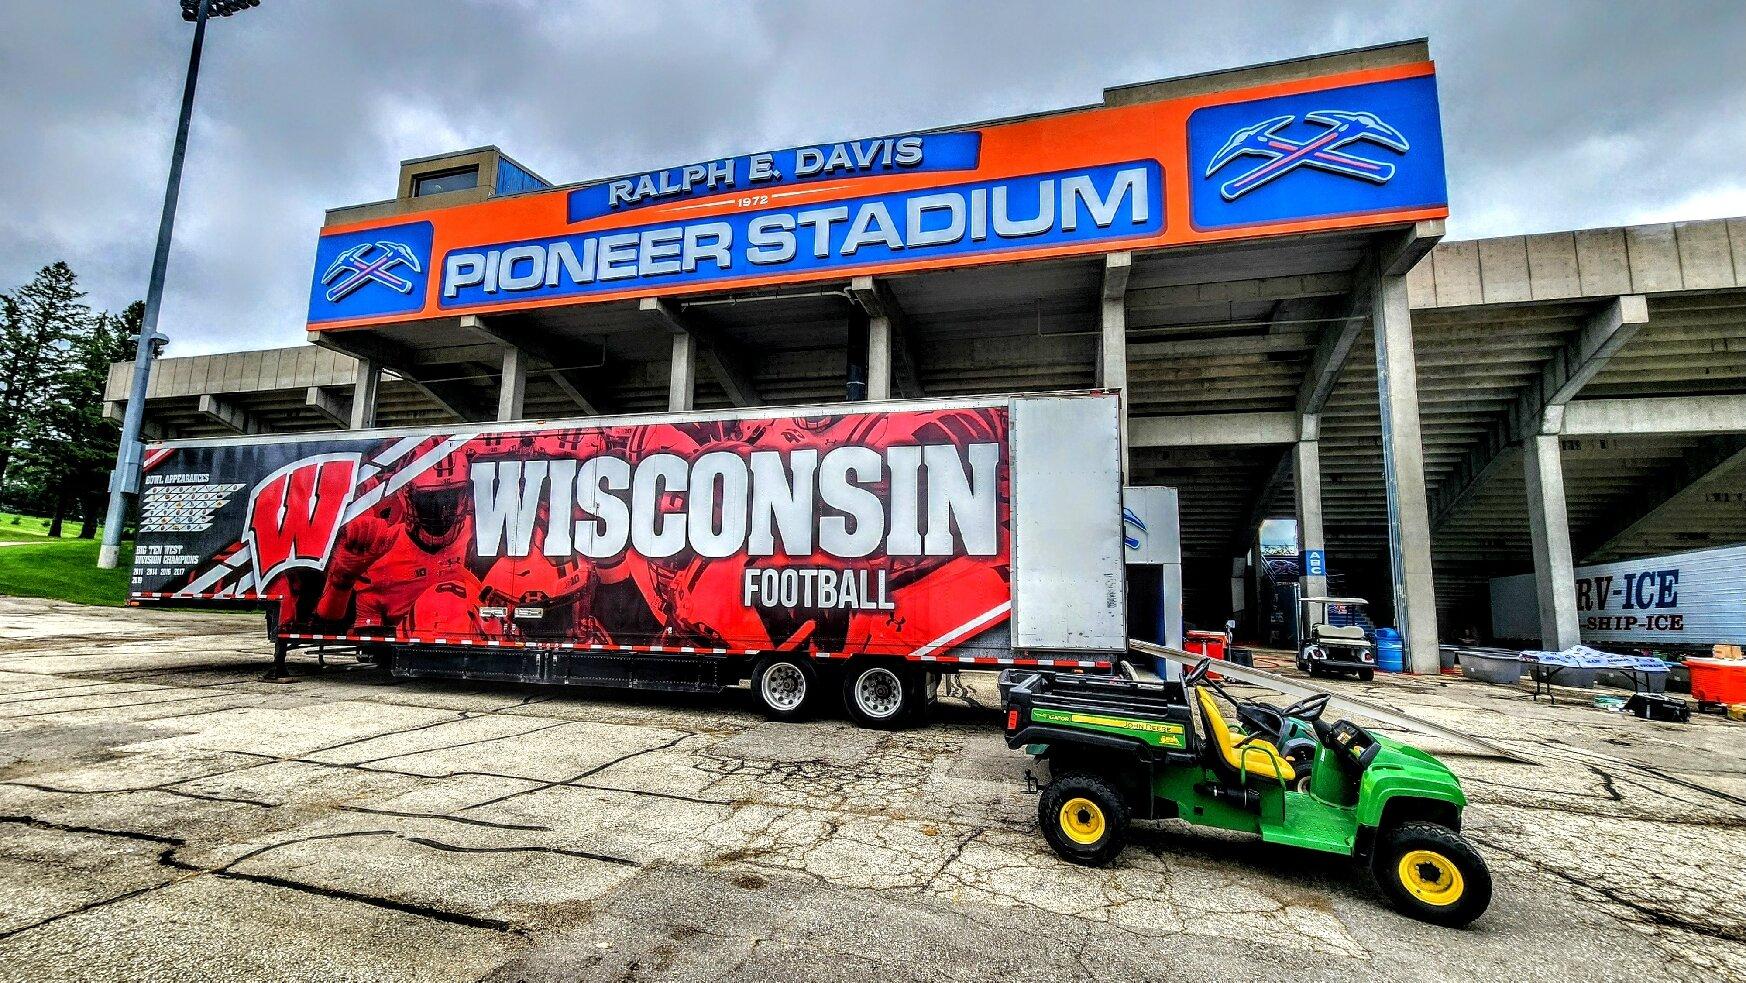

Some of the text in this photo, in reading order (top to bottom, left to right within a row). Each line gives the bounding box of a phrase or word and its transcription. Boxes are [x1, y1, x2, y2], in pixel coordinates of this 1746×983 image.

[608, 136, 923, 208] RALPH E. DAVIS
[737, 195, 768, 208] 1972
[443, 167, 1149, 298] PIONEER STADIUM
[145, 473, 210, 484] BOWL APPEARANCES
[470, 442, 999, 558] WISCONSIN
[241, 452, 362, 596] W
[136, 545, 183, 555] BIG TEN WEST
[134, 555, 200, 565] DIVISION CHAMPIONS
[173, 567, 185, 576] 2017
[744, 569, 895, 609] FOOTBALL
[1049, 714, 1069, 722] GATOR
[1123, 721, 1172, 733] JOHN DEERE
